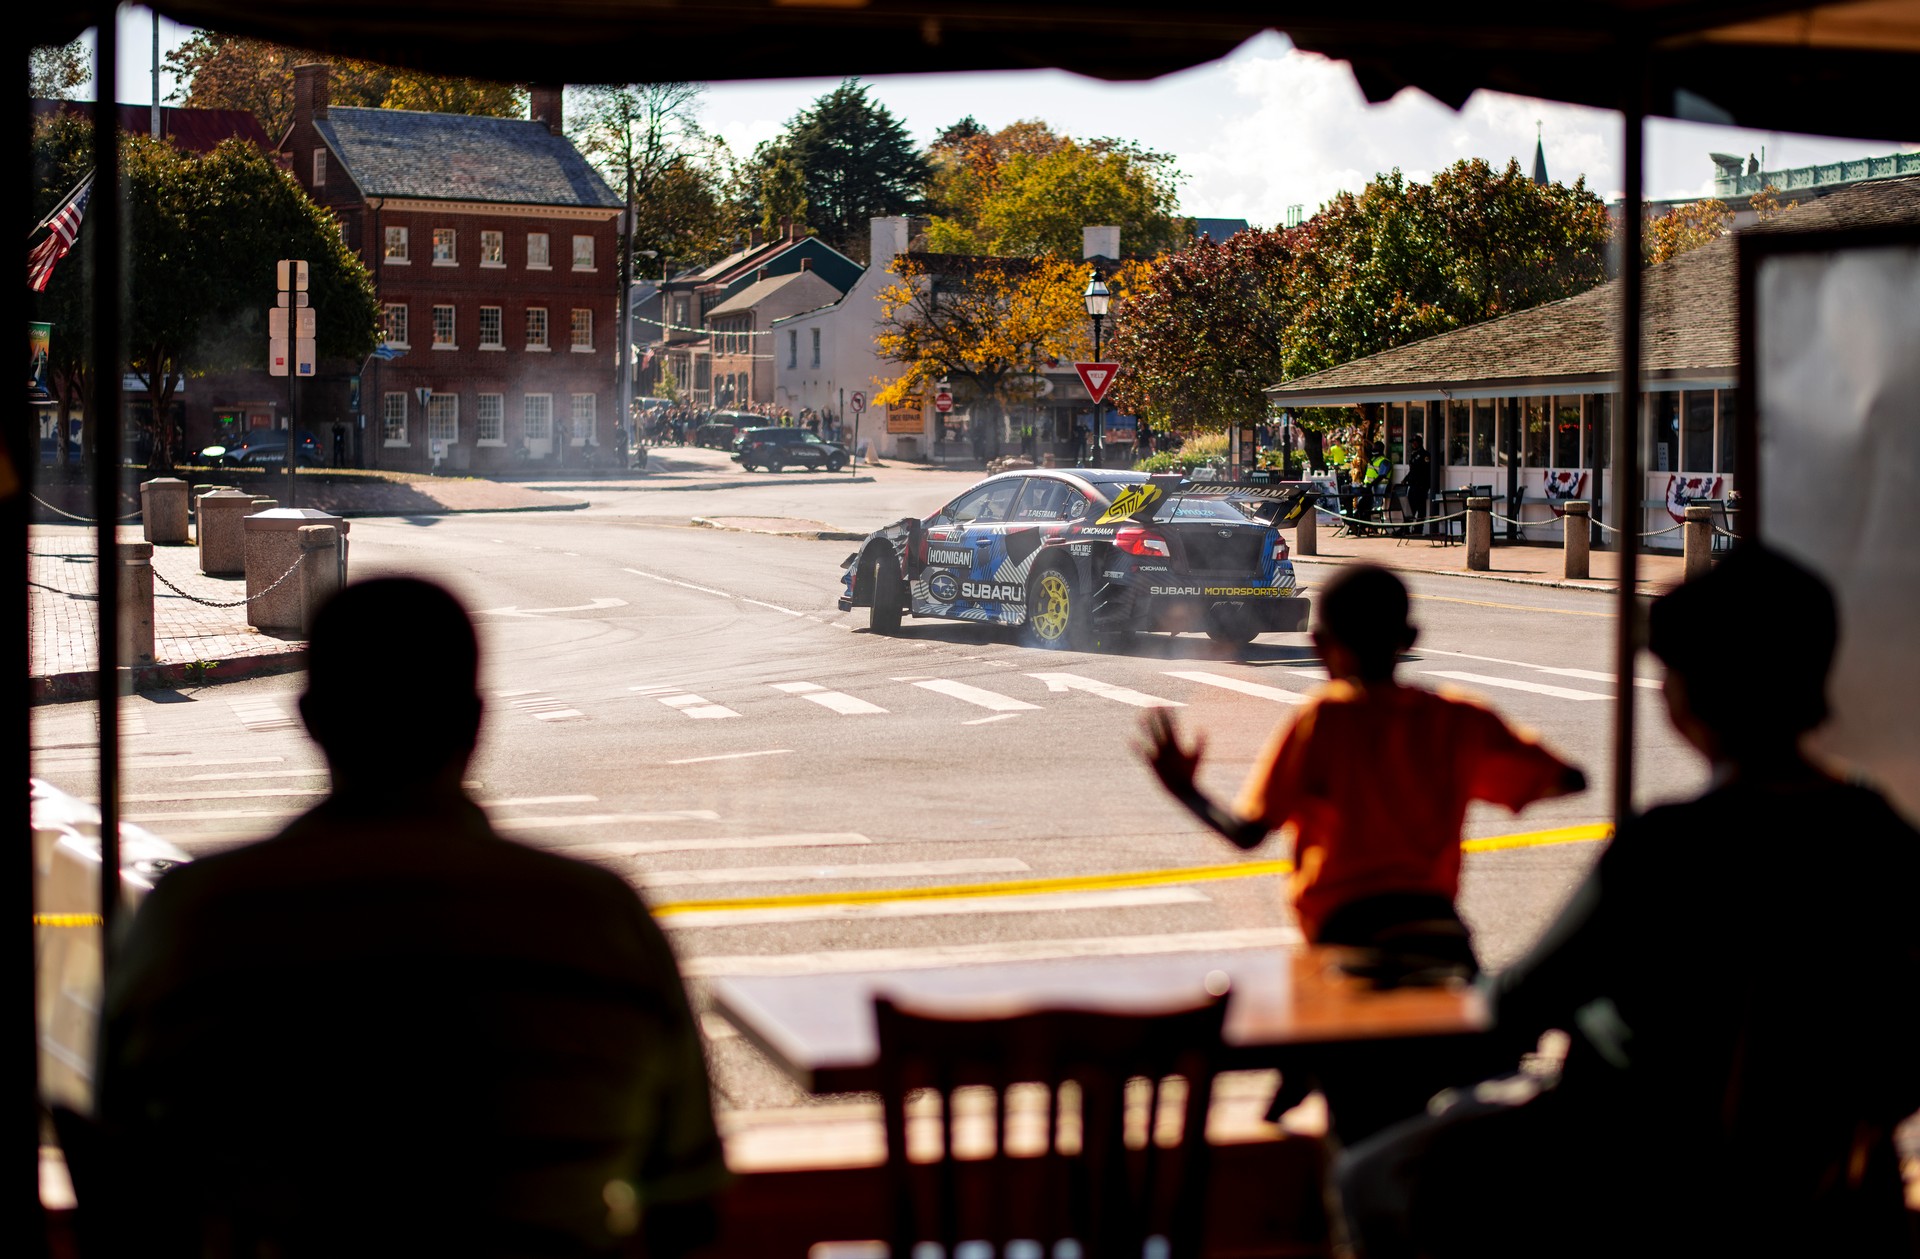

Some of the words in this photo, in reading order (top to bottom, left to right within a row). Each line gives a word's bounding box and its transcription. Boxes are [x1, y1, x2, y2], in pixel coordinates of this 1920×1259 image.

[1108, 491, 1139, 518] STI
[1080, 527, 1114, 535] YOKOHAMA
[1070, 544, 1081, 552] BLACK
[1082, 544, 1091, 553] RIFLE
[961, 582, 1022, 601] SUBARU
[1150, 586, 1200, 595] SUBARU
[1204, 587, 1278, 596] MOTORSPORTS
